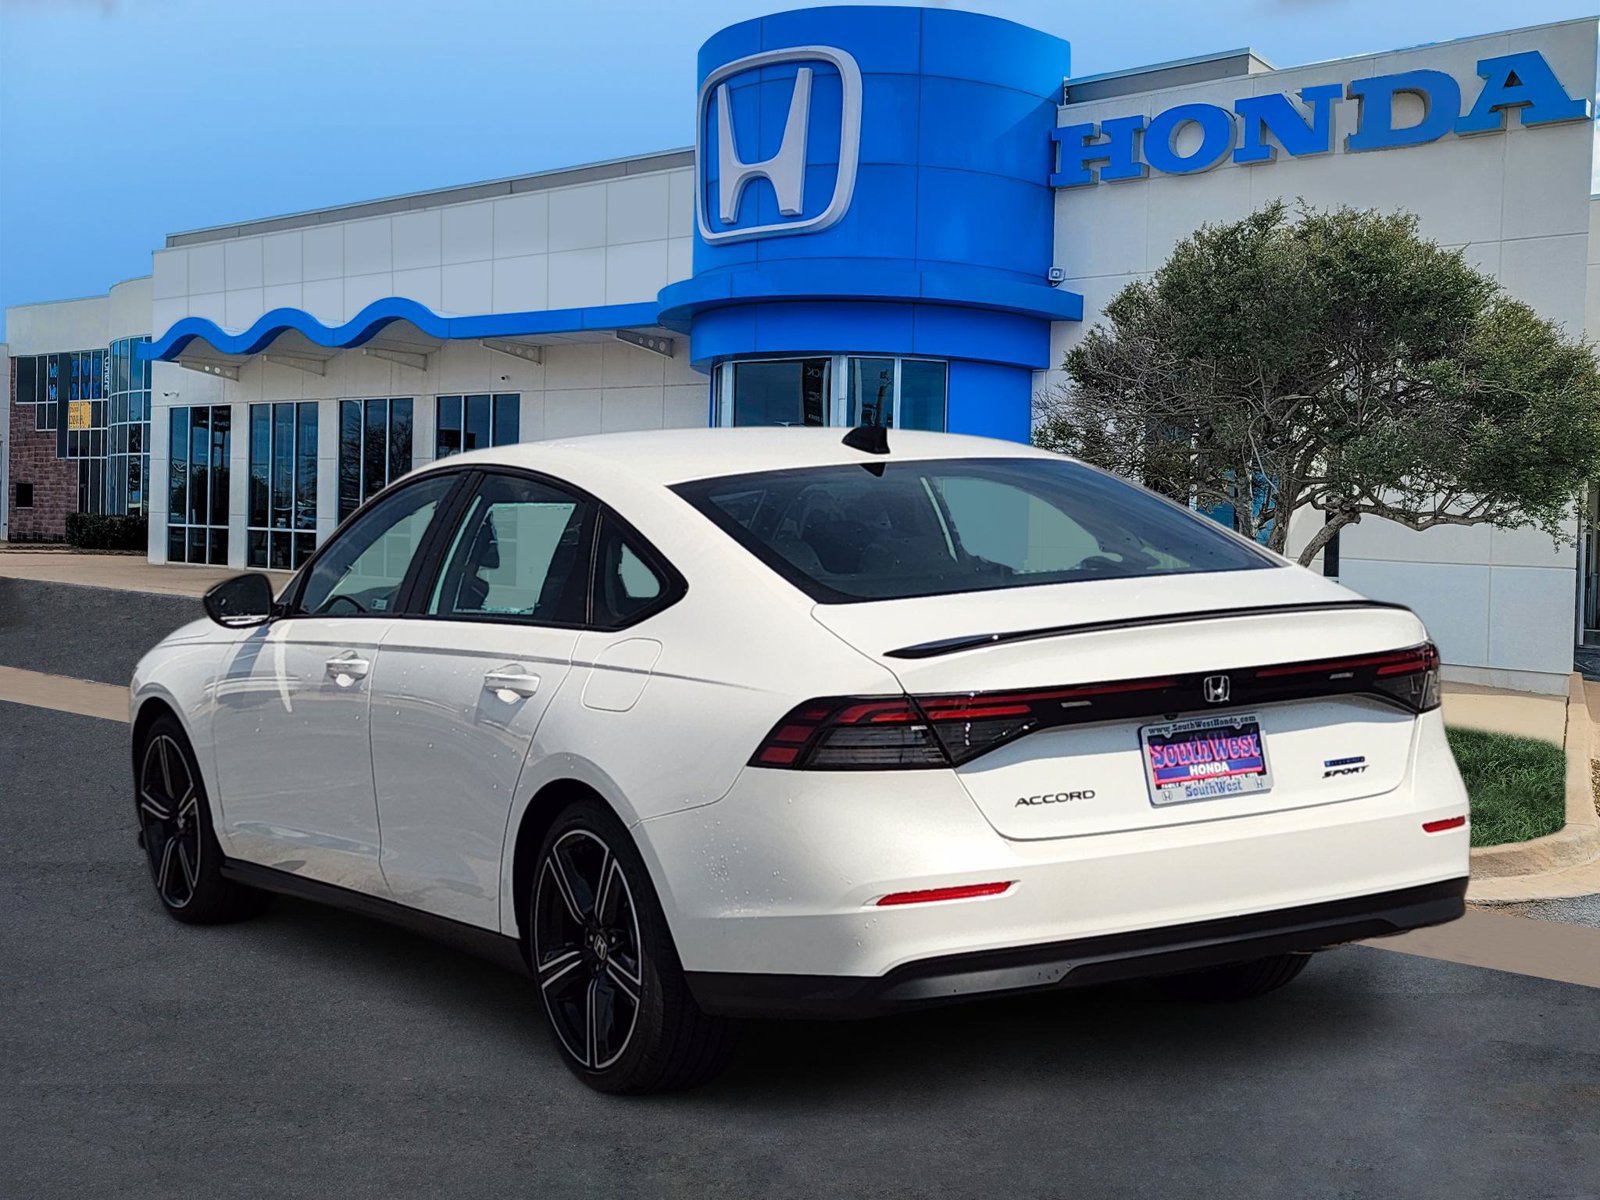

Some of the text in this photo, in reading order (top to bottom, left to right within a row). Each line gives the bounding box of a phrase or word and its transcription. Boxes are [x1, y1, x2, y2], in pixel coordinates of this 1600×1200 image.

[1049, 50, 1591, 188] HONDA
[1189, 762, 1230, 776] HONDA
[1321, 764, 1370, 779] SPORT
[1185, 781, 1243, 797] SouthWest
[1014, 790, 1096, 807] ACCORD
